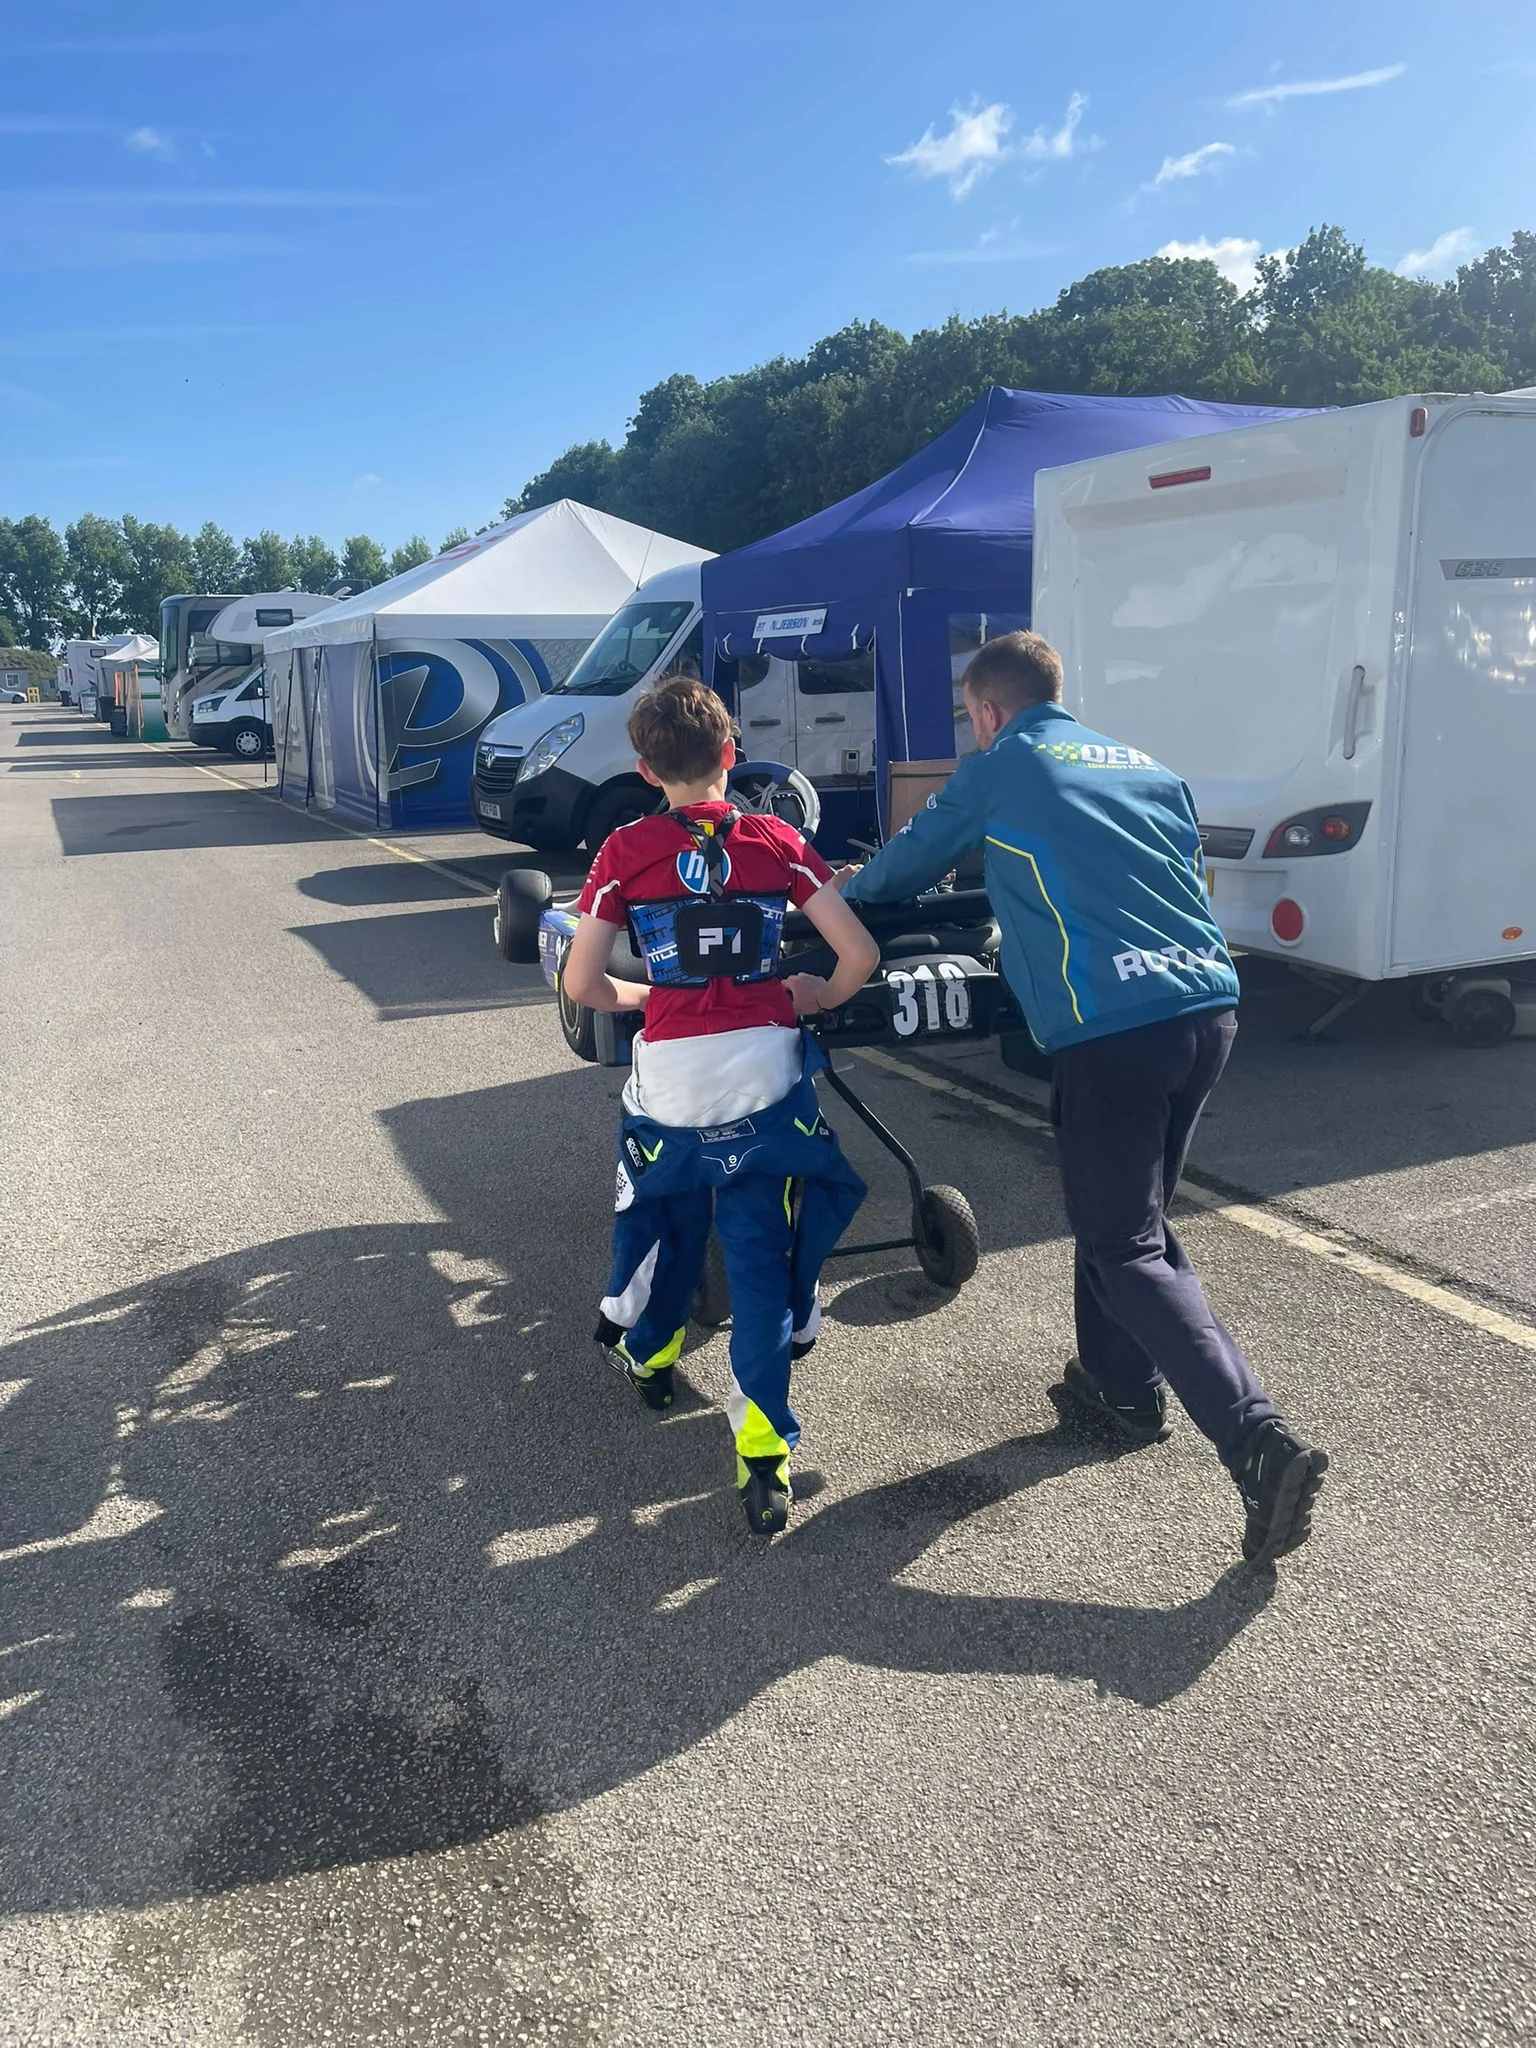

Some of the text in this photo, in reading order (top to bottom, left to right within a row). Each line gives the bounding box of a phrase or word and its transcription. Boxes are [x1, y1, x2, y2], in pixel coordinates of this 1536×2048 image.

[1454, 560, 1506, 578] 636
[1081, 743, 1156, 766] DER
[1112, 944, 1220, 982] ROTAX
[887, 962, 969, 1036] 318
